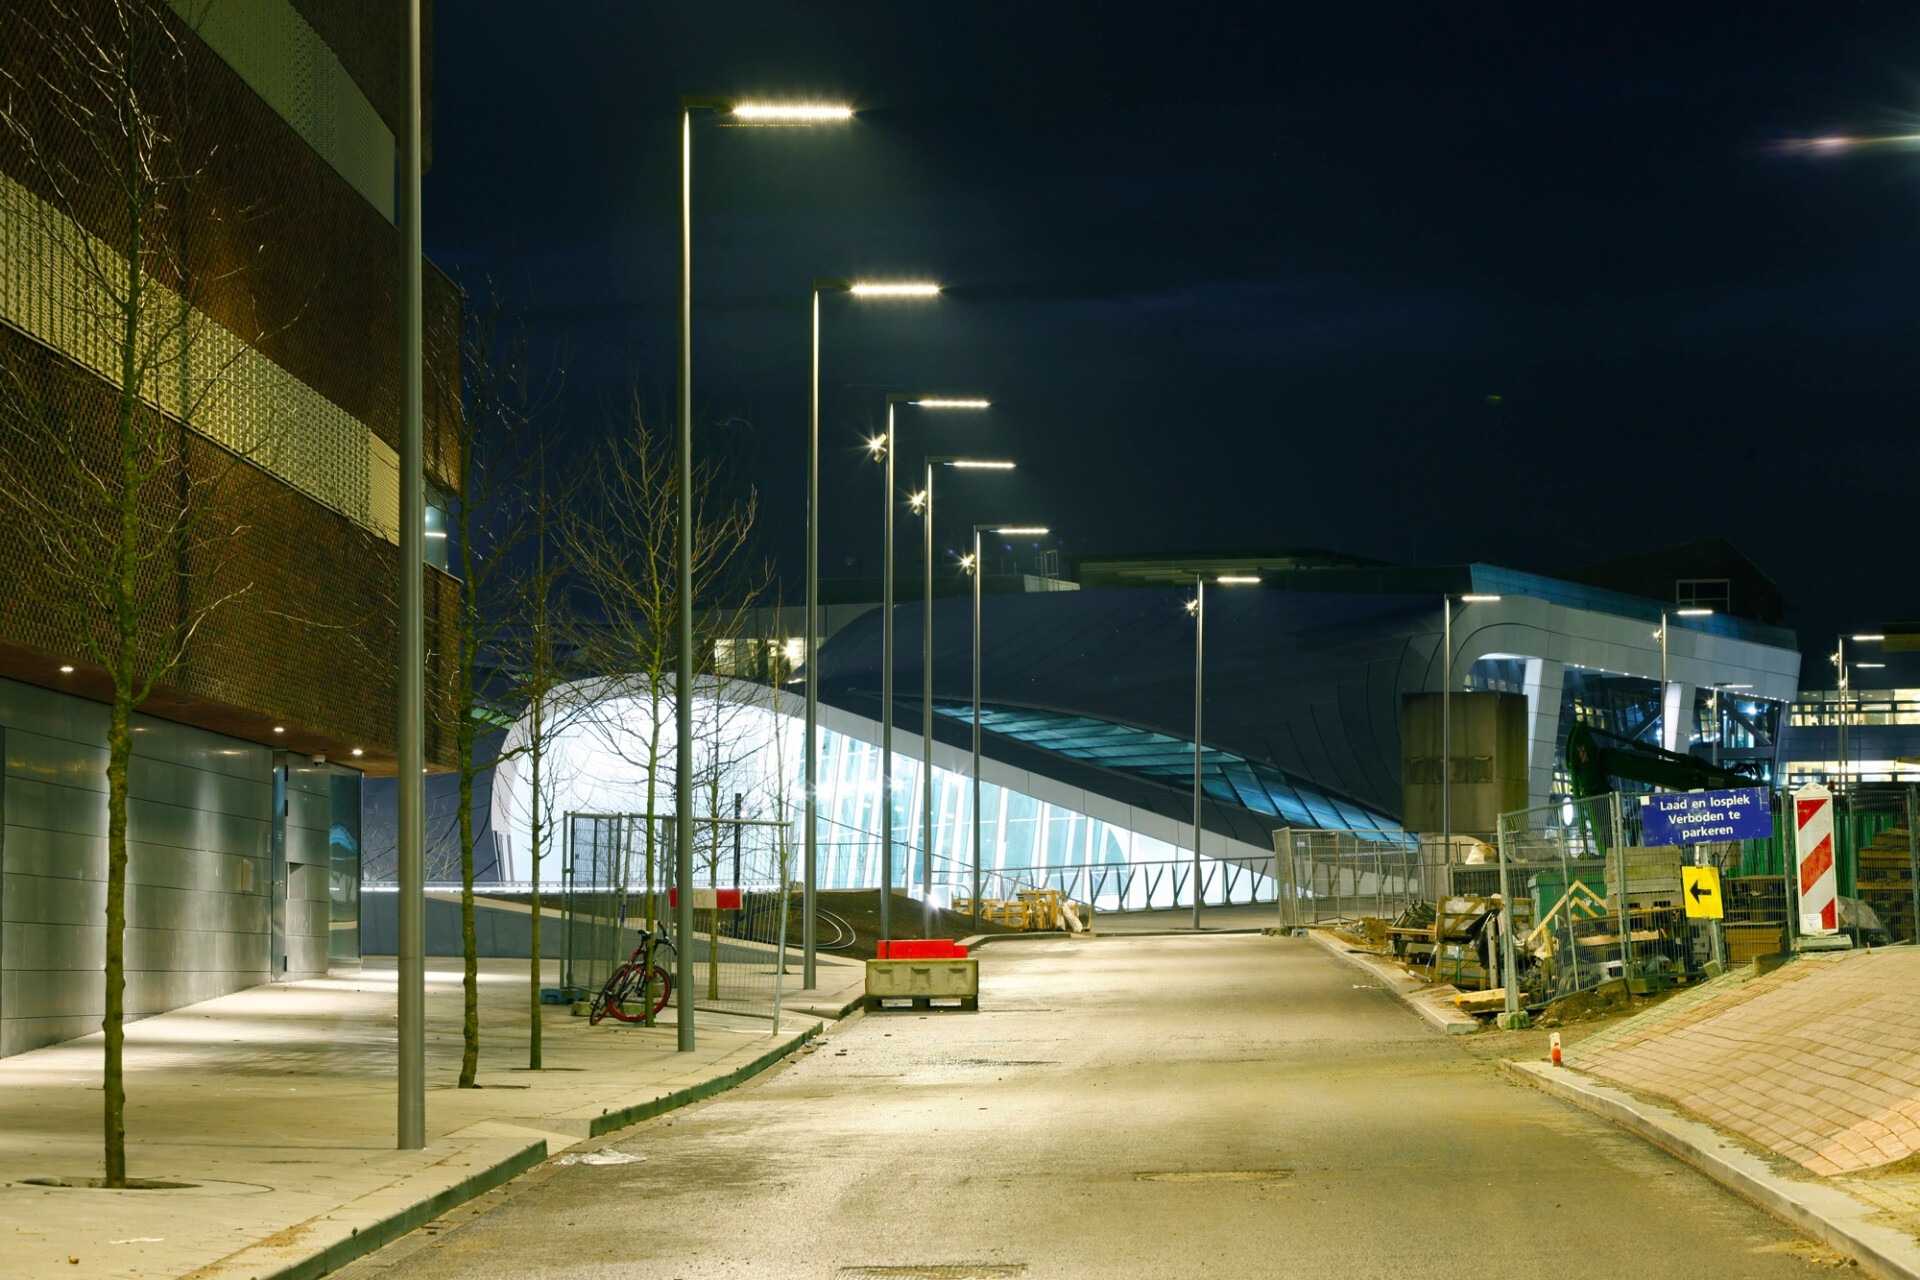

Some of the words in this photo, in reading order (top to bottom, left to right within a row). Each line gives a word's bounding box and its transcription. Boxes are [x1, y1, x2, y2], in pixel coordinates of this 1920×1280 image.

[1660, 798, 1687, 811] Laad
[1692, 799, 1706, 809] en
[1710, 794, 1750, 808] losplek
[1668, 811, 1724, 825] Verboden
[1728, 810, 1741, 819] te
[1682, 826, 1733, 840] parkeren
